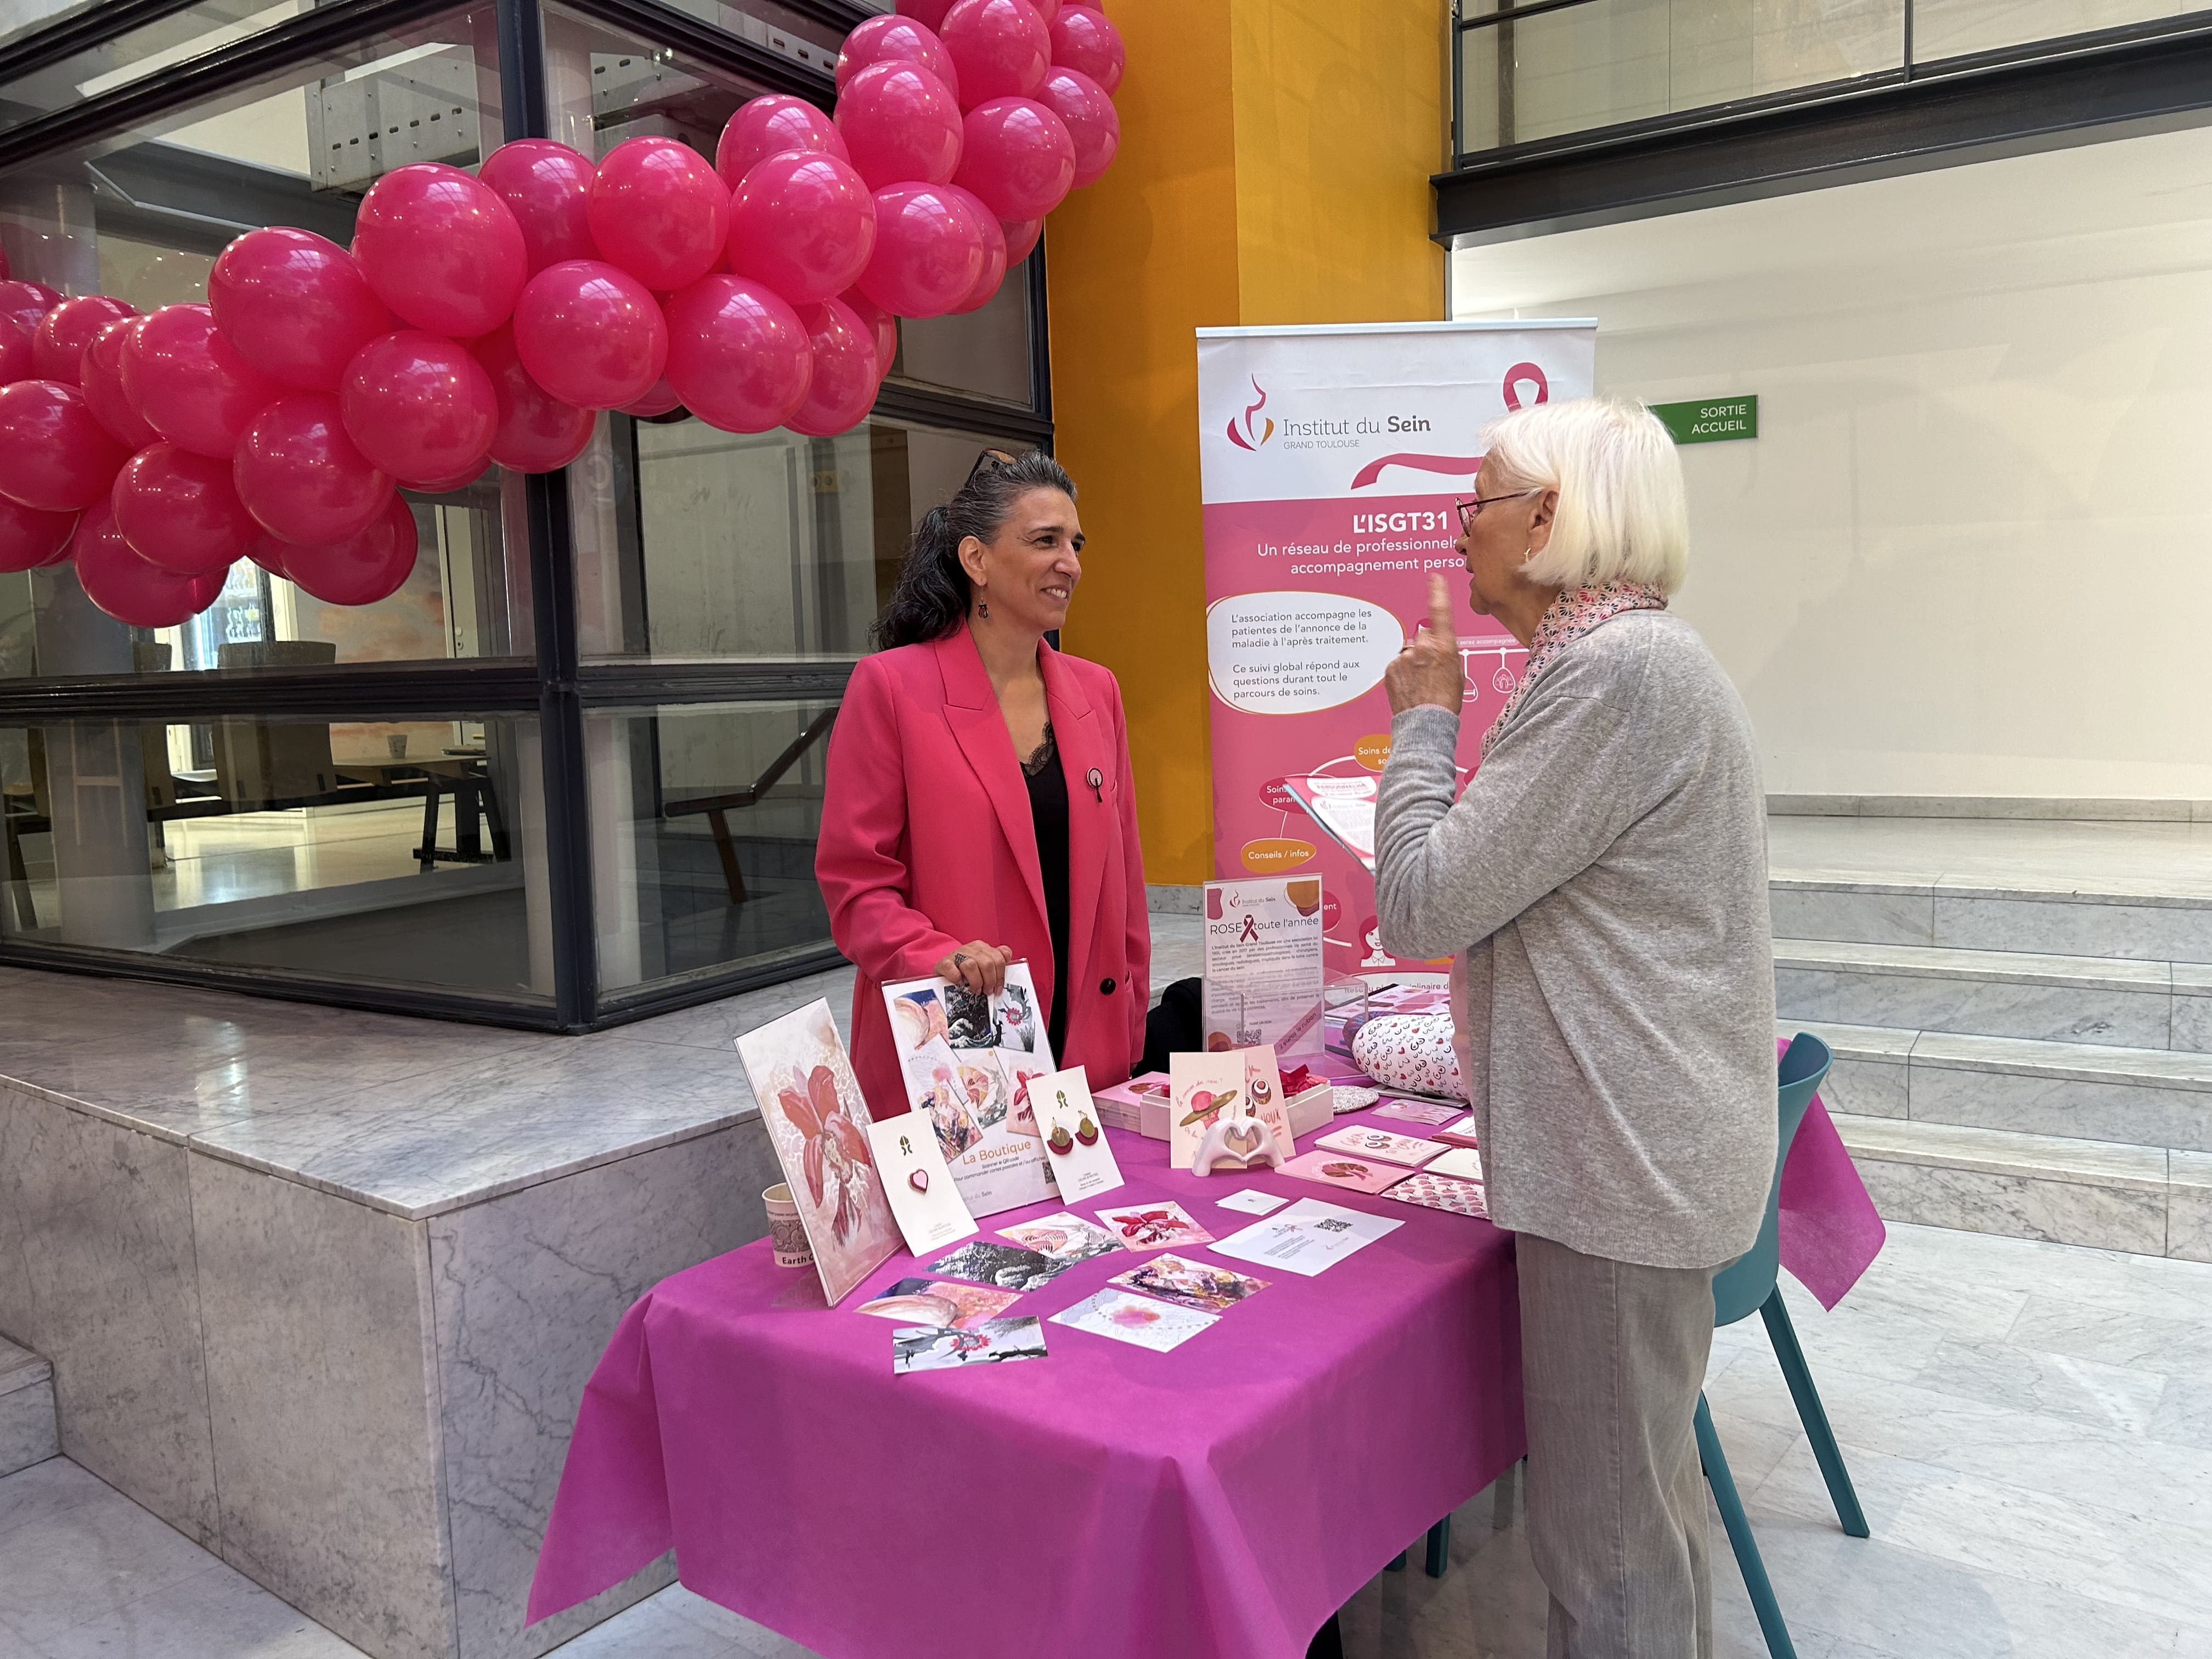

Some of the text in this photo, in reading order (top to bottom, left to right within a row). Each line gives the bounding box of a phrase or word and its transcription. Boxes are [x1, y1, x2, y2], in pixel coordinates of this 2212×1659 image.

[1700, 404, 1747, 418] SORTIE
[1283, 415, 1431, 436] Institut du Sein
[1691, 419, 1747, 434] ACCUEIL
[1283, 439, 1359, 449] GRAND TOULOUSE
[1353, 511, 1448, 534] L'ISGT31
[1257, 544, 1277, 556] Un
[1282, 541, 1328, 555] réseau
[1333, 540, 1352, 553] de
[1290, 557, 1466, 576] accompagnement perso
[1232, 608, 1372, 623] L'association accompagne les
[1232, 622, 1367, 638] patientes de l'annonce de la
[1232, 635, 1369, 648] maladie à l'après traitement.
[1233, 664, 1246, 673] Ce
[1249, 663, 1270, 673] suivi
[1273, 662, 1303, 674] global
[1305, 660, 1340, 673] répond
[1233, 673, 1347, 688] questions durant tout le
[1233, 686, 1320, 701] parcours de soins.
[1358, 747, 1380, 755] Soins
[1266, 785, 1286, 793] Soin
[1248, 849, 1309, 860] Conseils / infos
[1210, 917, 1319, 935] ROSE toute l'année
[1283, 1031, 1297, 1046] euros
[1301, 1013, 1317, 1028] ruban
[962, 1141, 1031, 1165] La Boutique
[782, 1256, 806, 1265] Earth
